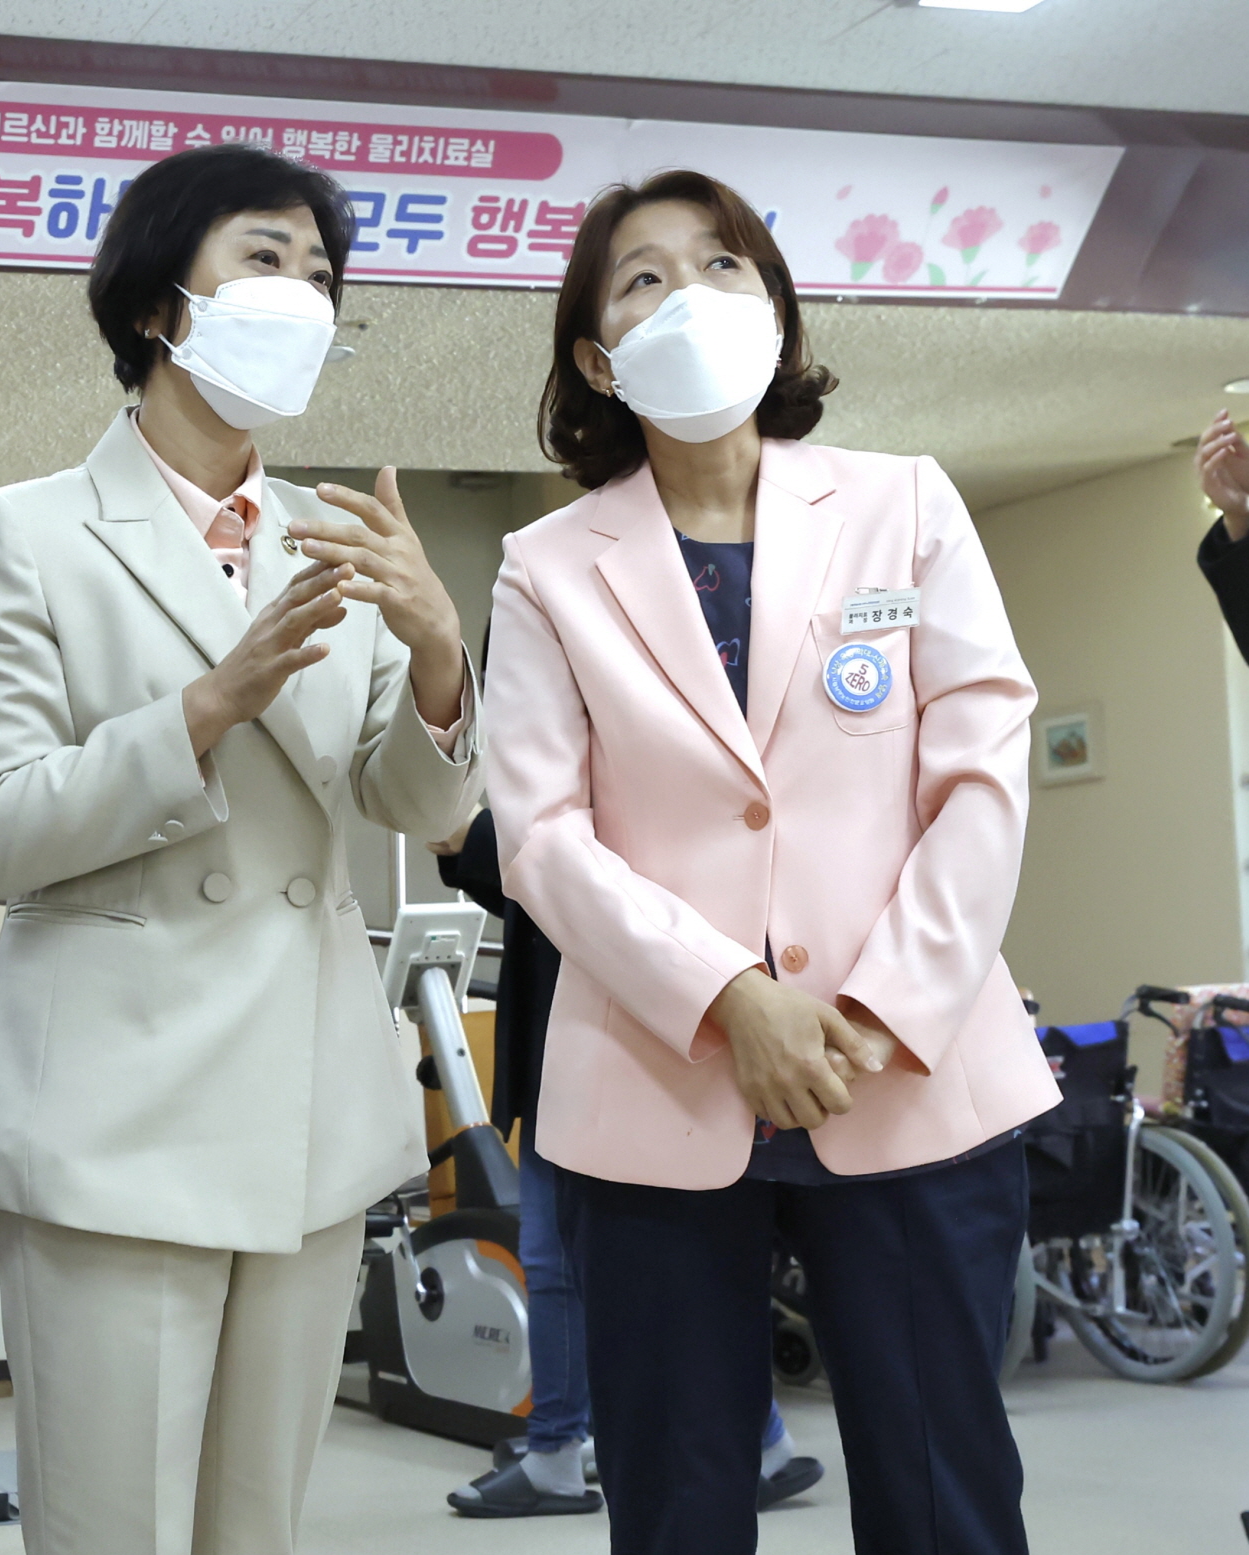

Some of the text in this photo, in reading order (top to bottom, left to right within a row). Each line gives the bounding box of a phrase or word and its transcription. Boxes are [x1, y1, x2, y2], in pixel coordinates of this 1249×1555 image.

[93, 117, 178, 150] 함께할
[184, 124, 211, 146] 수
[282, 128, 361, 160] 행복한
[368, 133, 495, 168] 물리치료실
[858, 663, 869, 675] 5
[845, 672, 870, 692] ZERO
